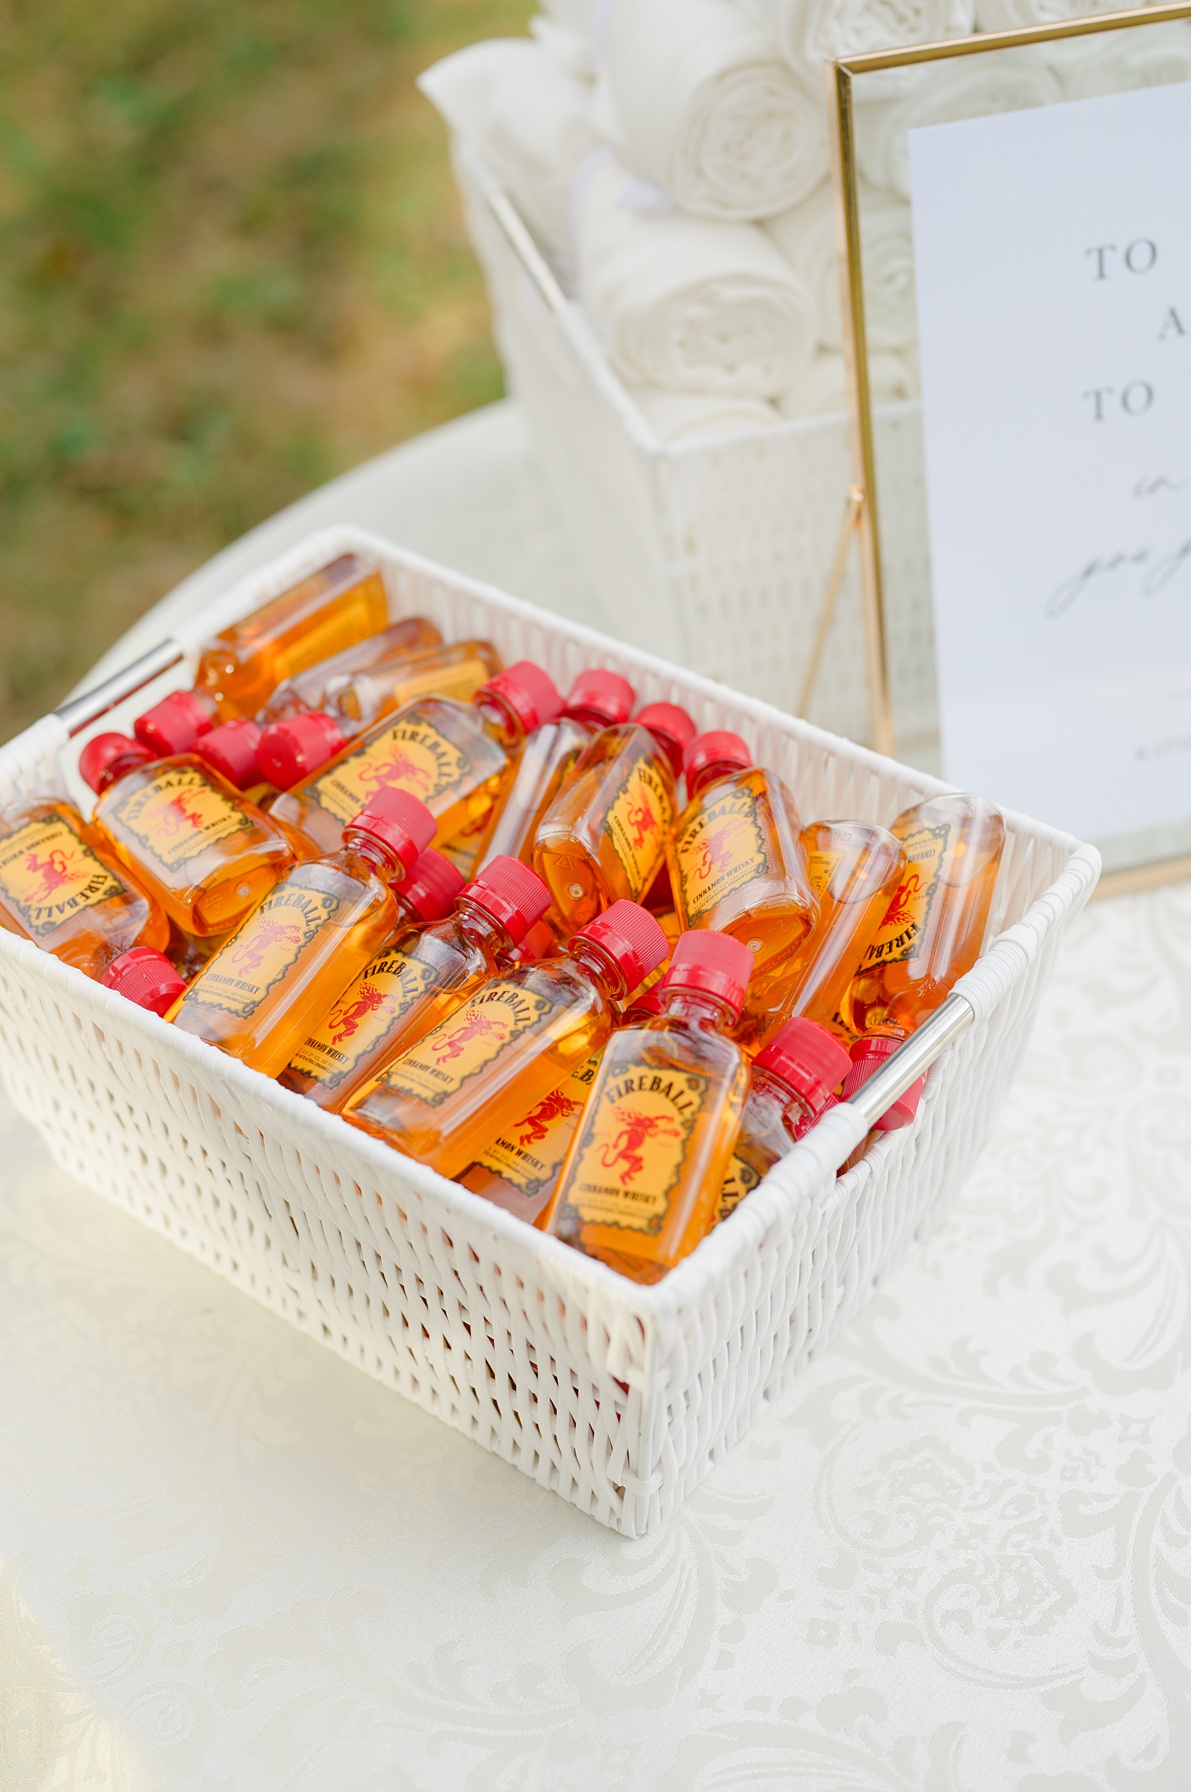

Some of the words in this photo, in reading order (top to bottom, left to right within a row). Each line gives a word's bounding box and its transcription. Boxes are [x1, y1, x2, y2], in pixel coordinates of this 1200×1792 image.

[1083, 236, 1158, 282] TO
[1081, 378, 1155, 423] TO
[392, 729, 453, 779] FIREBALL
[127, 777, 196, 820] FIREBALL
[680, 802, 747, 853] FIREBALL
[35, 874, 108, 920] FIREBALL
[693, 875, 725, 903] CINNAMON
[726, 857, 755, 877] WHISKY
[260, 893, 322, 927] FIREBALL
[206, 973, 236, 986] CINNAMON
[234, 979, 261, 995] WHISKY
[363, 959, 418, 998] FIREBALL
[470, 990, 531, 1026] FIREBALL
[325, 1046, 350, 1064] WHISKY
[403, 1058, 431, 1072] CINNAMON
[429, 1067, 454, 1085] WHISKY
[605, 1074, 693, 1115] FIREBALL
[515, 1148, 546, 1171] WHISKY
